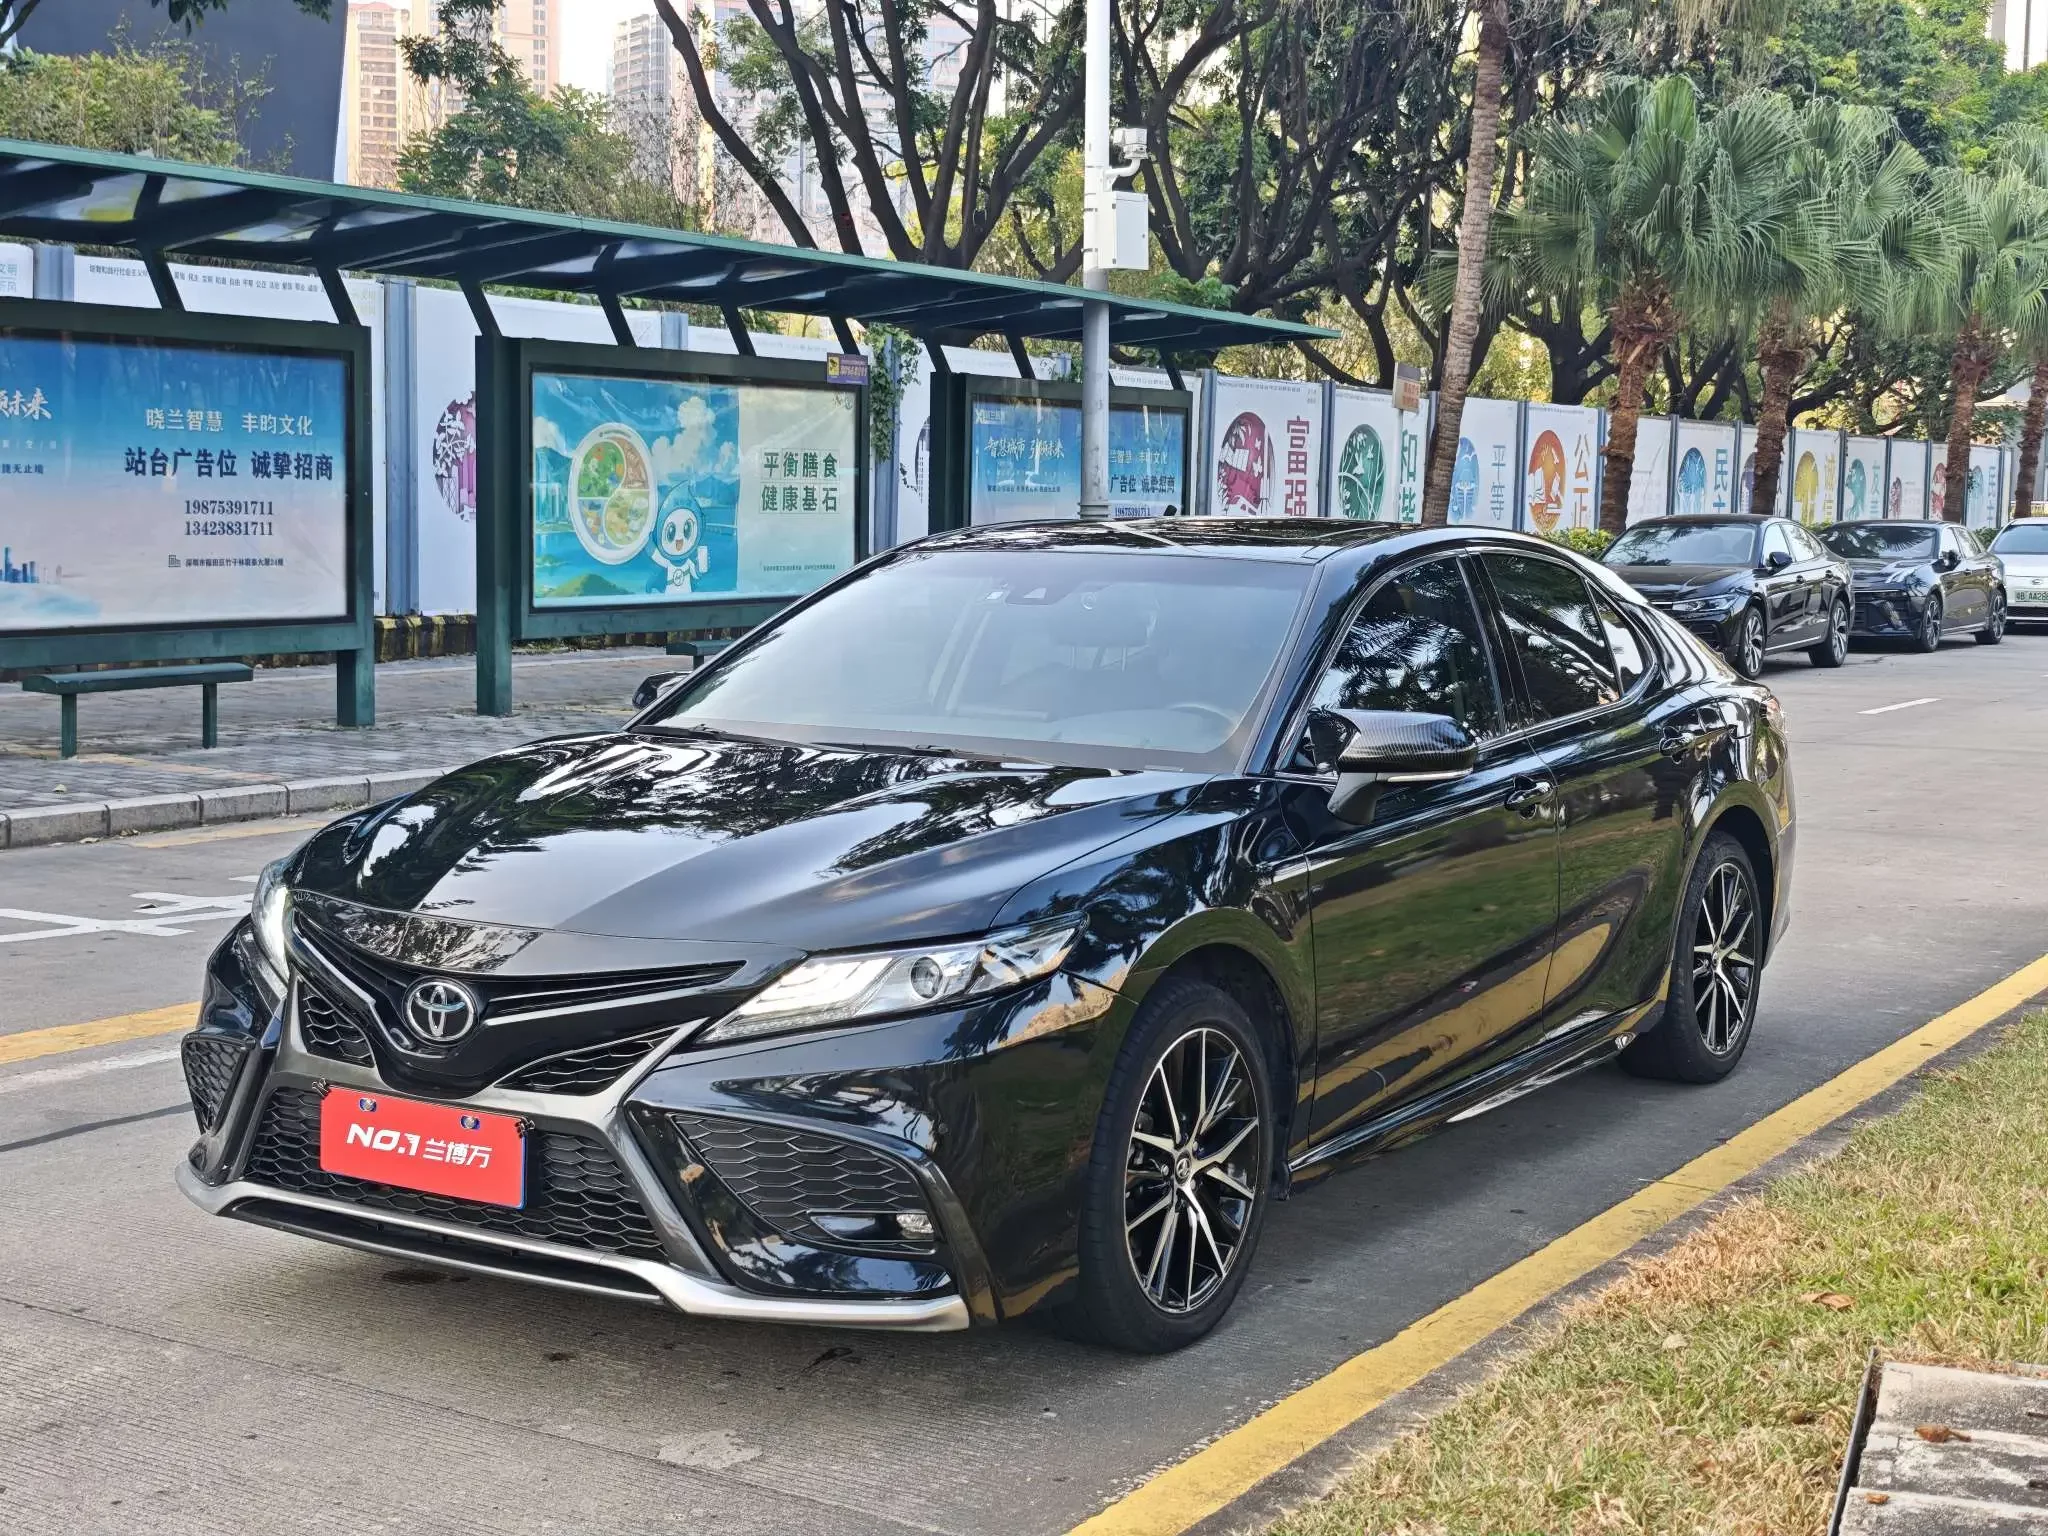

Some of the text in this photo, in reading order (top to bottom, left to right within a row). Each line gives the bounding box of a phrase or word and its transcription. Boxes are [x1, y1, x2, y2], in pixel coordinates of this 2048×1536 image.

[145, 407, 313, 437] 晓兰智慧 丰昀文化
[124, 447, 334, 481] 站台广告位 诚挚招商
[763, 451, 838, 478] 平衡膳食
[1284, 415, 1310, 517] 富强
[1490, 444, 1507, 521] 平等
[1573, 434, 1593, 529] 公正
[184, 499, 274, 516] 19875391711
[761, 486, 839, 512] 健康基石
[184, 520, 274, 537] 13423831711
[346, 1123, 493, 1169] NO.1 兰博万
